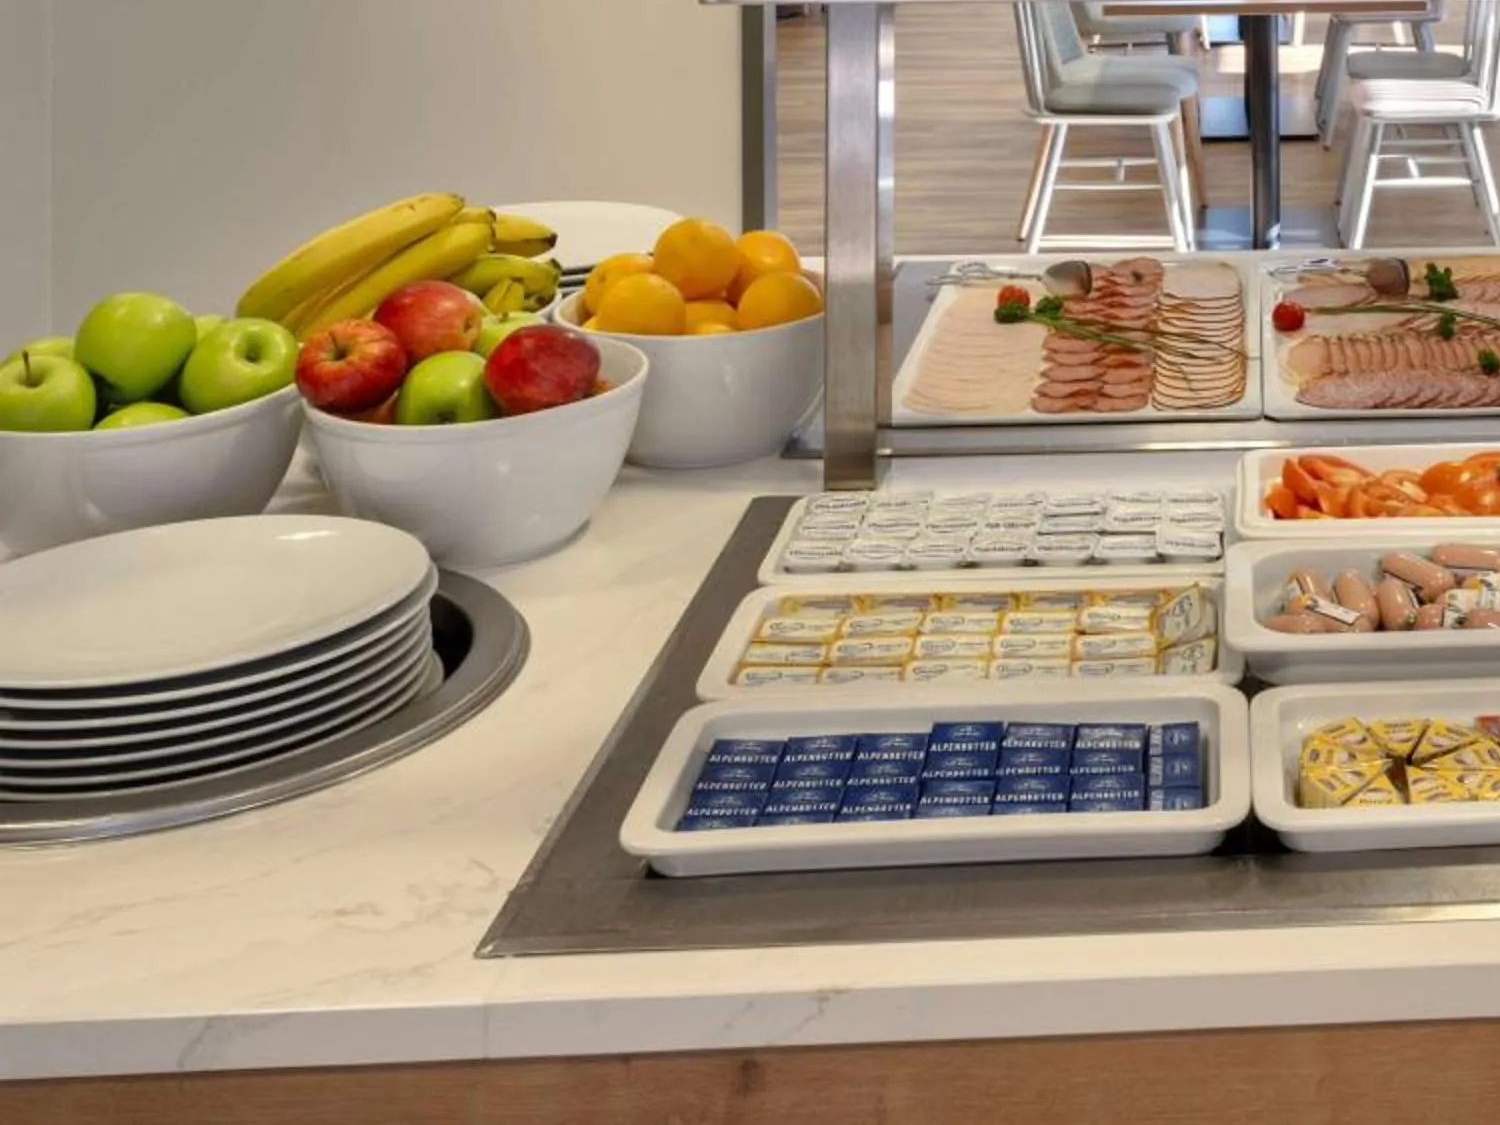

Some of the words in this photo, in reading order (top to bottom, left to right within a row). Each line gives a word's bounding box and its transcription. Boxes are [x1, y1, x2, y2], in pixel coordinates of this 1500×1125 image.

[930, 741, 997, 751] ALPENBUTTER
[1002, 739, 1067, 748] ALPENBUTTER
[1076, 740, 1141, 749] ALPENBUTTER
[709, 754, 778, 764] ALPENBUTTER
[784, 752, 852, 763] ALPENBUTTER
[858, 751, 925, 761] ALPENBUTTER
[995, 793, 1064, 802] ALPENBUTTER
[1071, 790, 1139, 800] ALPENBUTTER
[920, 796, 989, 804] ALPENBUTTER
[687, 807, 758, 816] ALPENBUTTER
[766, 803, 836, 812] ALPENBUTTER
[841, 804, 911, 814] ALPENBUTTER
